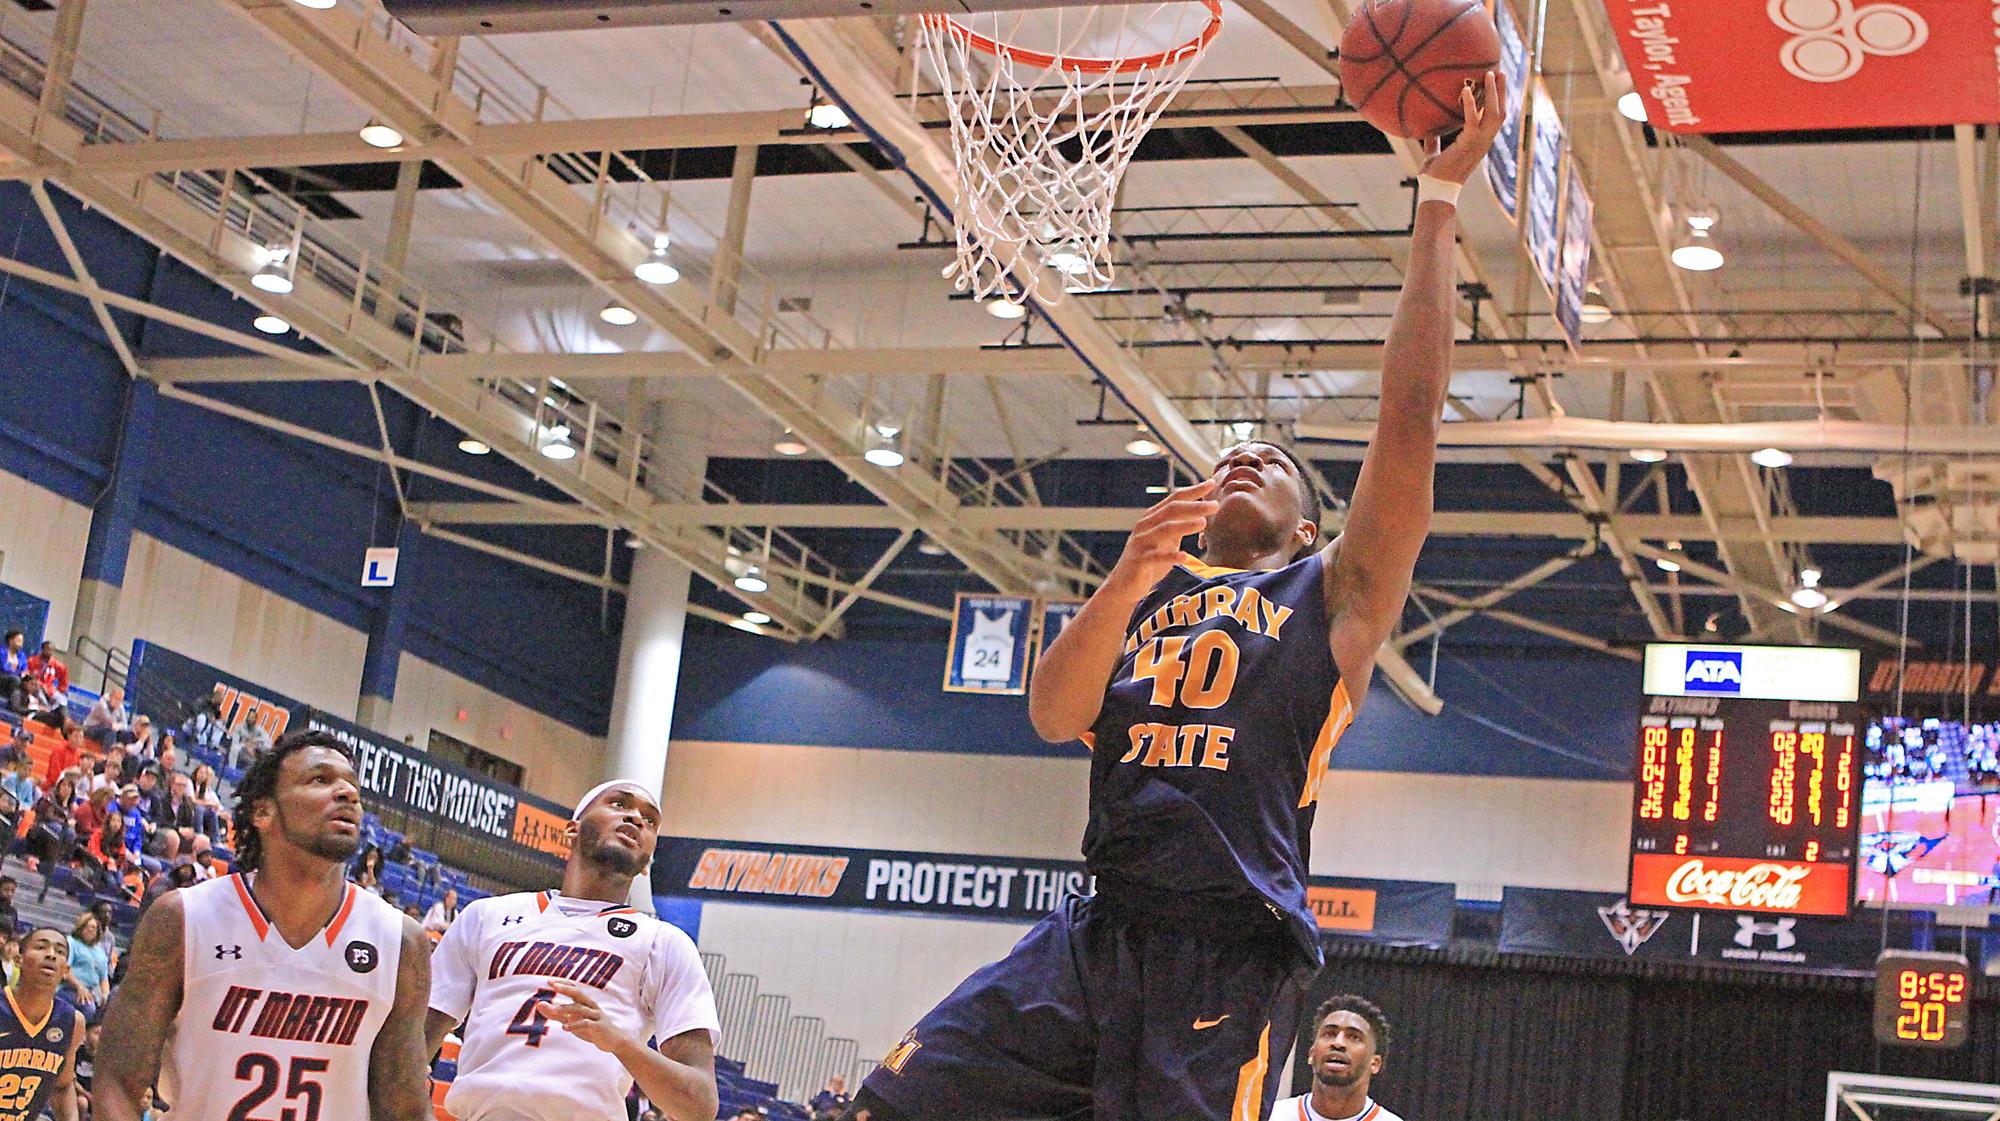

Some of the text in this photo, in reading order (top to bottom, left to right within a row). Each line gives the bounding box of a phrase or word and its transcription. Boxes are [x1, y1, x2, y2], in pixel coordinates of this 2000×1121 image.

[1629, 3, 1701, 126] Taylor, Agent
[369, 561, 388, 580] L
[1125, 585, 1294, 655] URRAY
[974, 650, 1000, 668] 24
[1131, 629, 1240, 709] 40
[1685, 659, 1742, 684] ATA
[1645, 728, 1667, 747] 00
[1682, 728, 1694, 747] 0
[1773, 732, 1796, 752] 02
[1644, 747, 1666, 765] 01
[1643, 764, 1665, 782] 04
[1838, 772, 1849, 791] 0
[405, 758, 442, 813] THIS
[1641, 799, 1662, 818] 25
[1770, 805, 1792, 825] 40
[1837, 807, 1848, 827] 3
[1675, 835, 1687, 854] 2
[1806, 841, 1818, 861] 2
[688, 849, 849, 898] SKYHAWKS
[865, 859, 1018, 909] PROTECT
[1023, 867, 1084, 912] THIS
[613, 921, 631, 933] PS
[352, 948, 371, 965] PS
[488, 941, 624, 990] UT MARTIN
[1900, 970, 1965, 1003] 8:52
[212, 985, 369, 1046] UT MARTIN
[506, 988, 557, 1048] 4
[1896, 1000, 1946, 1042] 20
[0, 1073, 41, 1110] 23
[227, 1052, 331, 1121] 25
